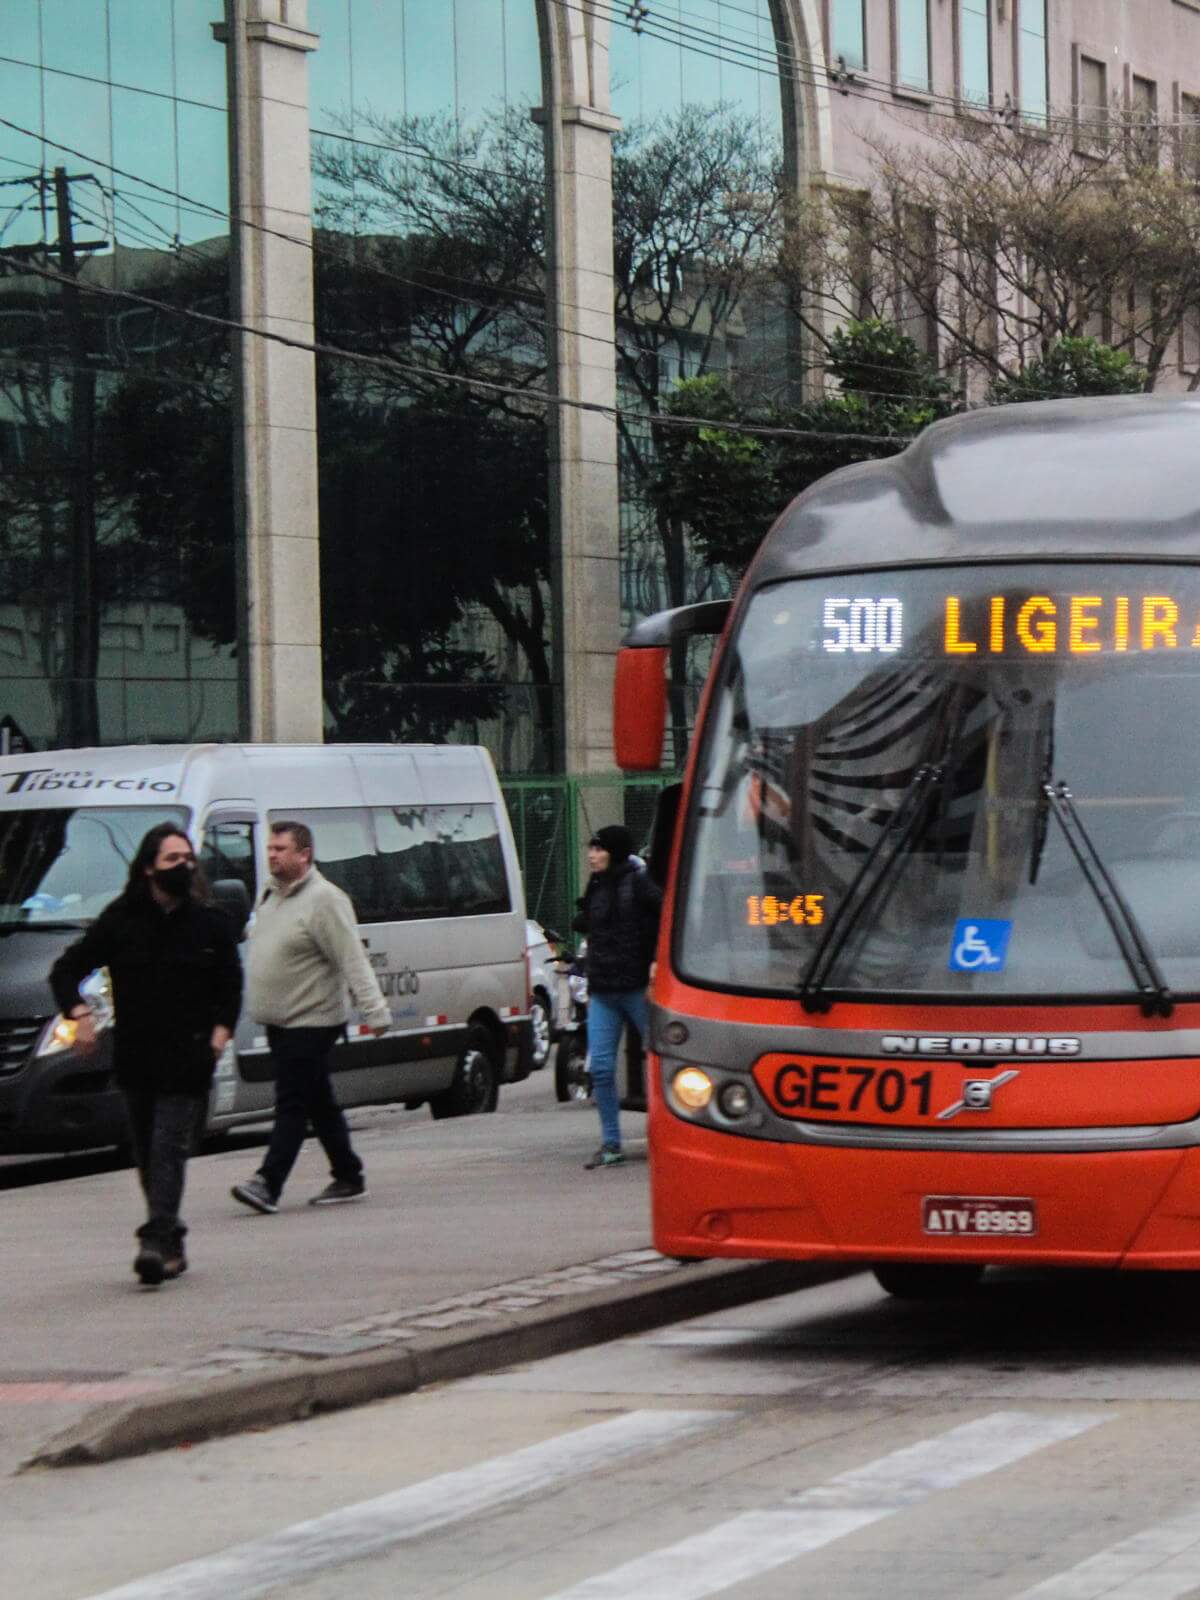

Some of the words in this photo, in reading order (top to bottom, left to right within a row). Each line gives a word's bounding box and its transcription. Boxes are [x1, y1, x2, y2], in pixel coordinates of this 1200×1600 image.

[822, 597, 902, 653] 500
[881, 1035, 1081, 1056] NEOBUS
[773, 1063, 934, 1116] GE701
[927, 1209, 1033, 1232] ATV-8969
